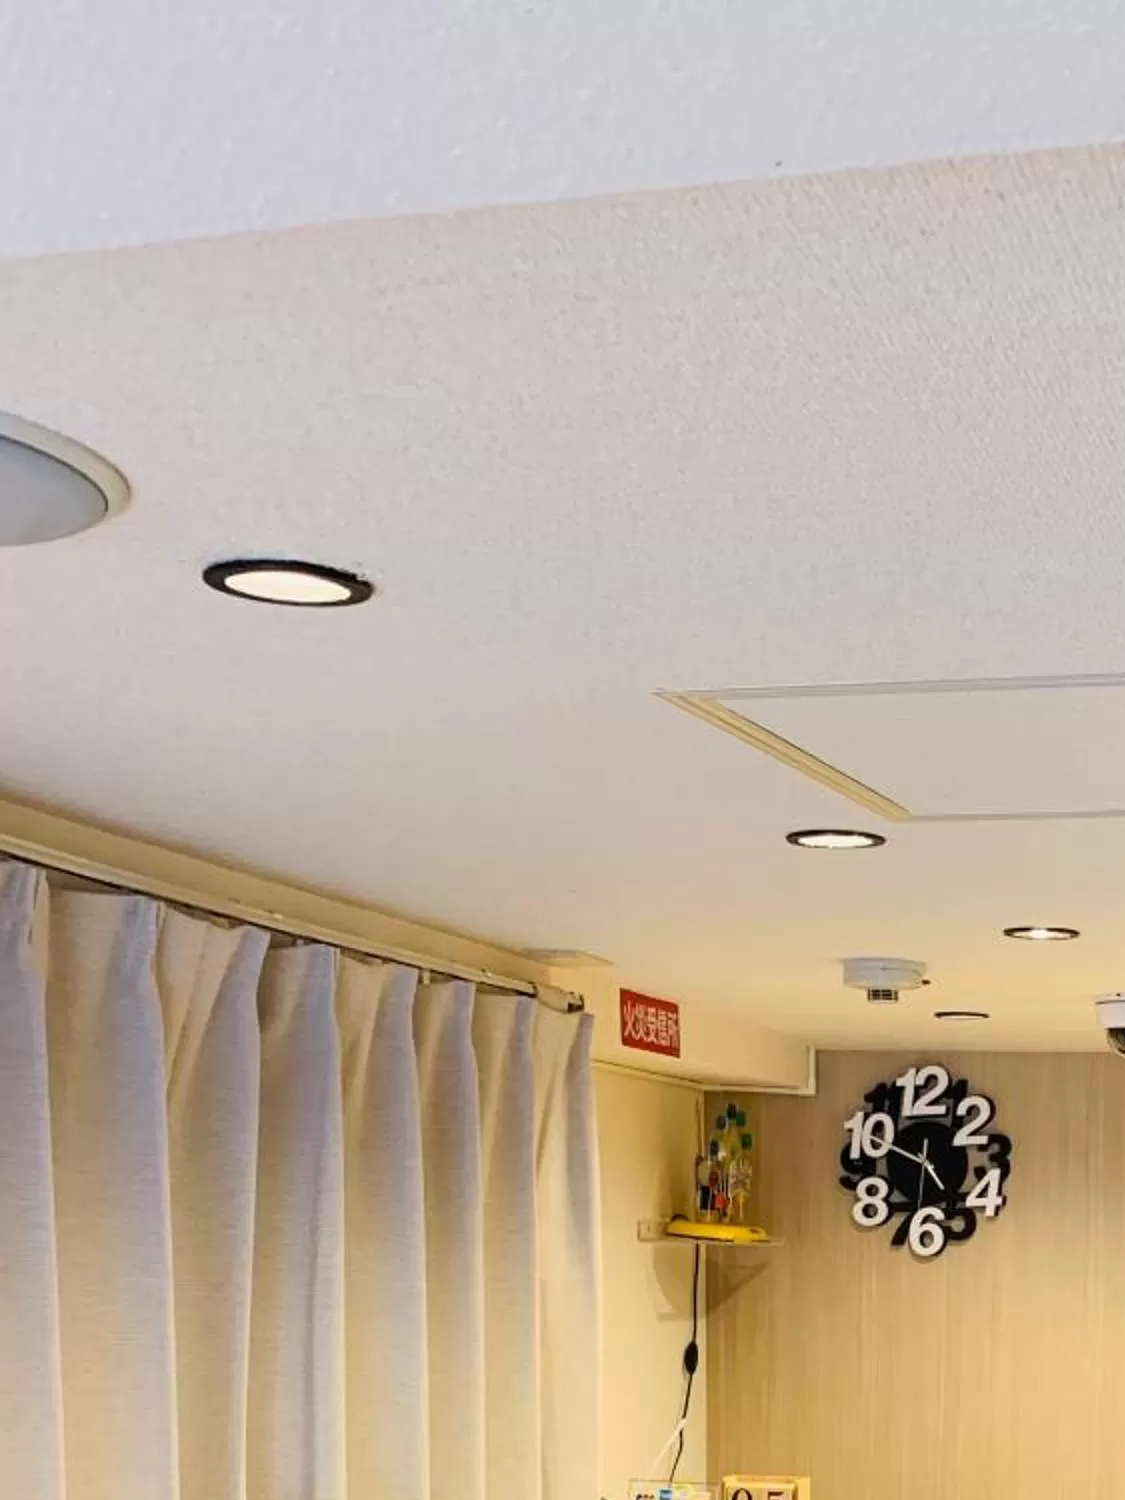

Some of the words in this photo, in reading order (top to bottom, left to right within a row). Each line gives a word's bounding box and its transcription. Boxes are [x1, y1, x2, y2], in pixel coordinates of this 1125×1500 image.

[895, 1065, 949, 1117] 12
[843, 1111, 895, 1159] 10
[952, 1095, 991, 1147] 2
[852, 1176, 889, 1227] 8
[966, 1168, 1003, 1217] 4
[909, 1206, 945, 1257] 6
